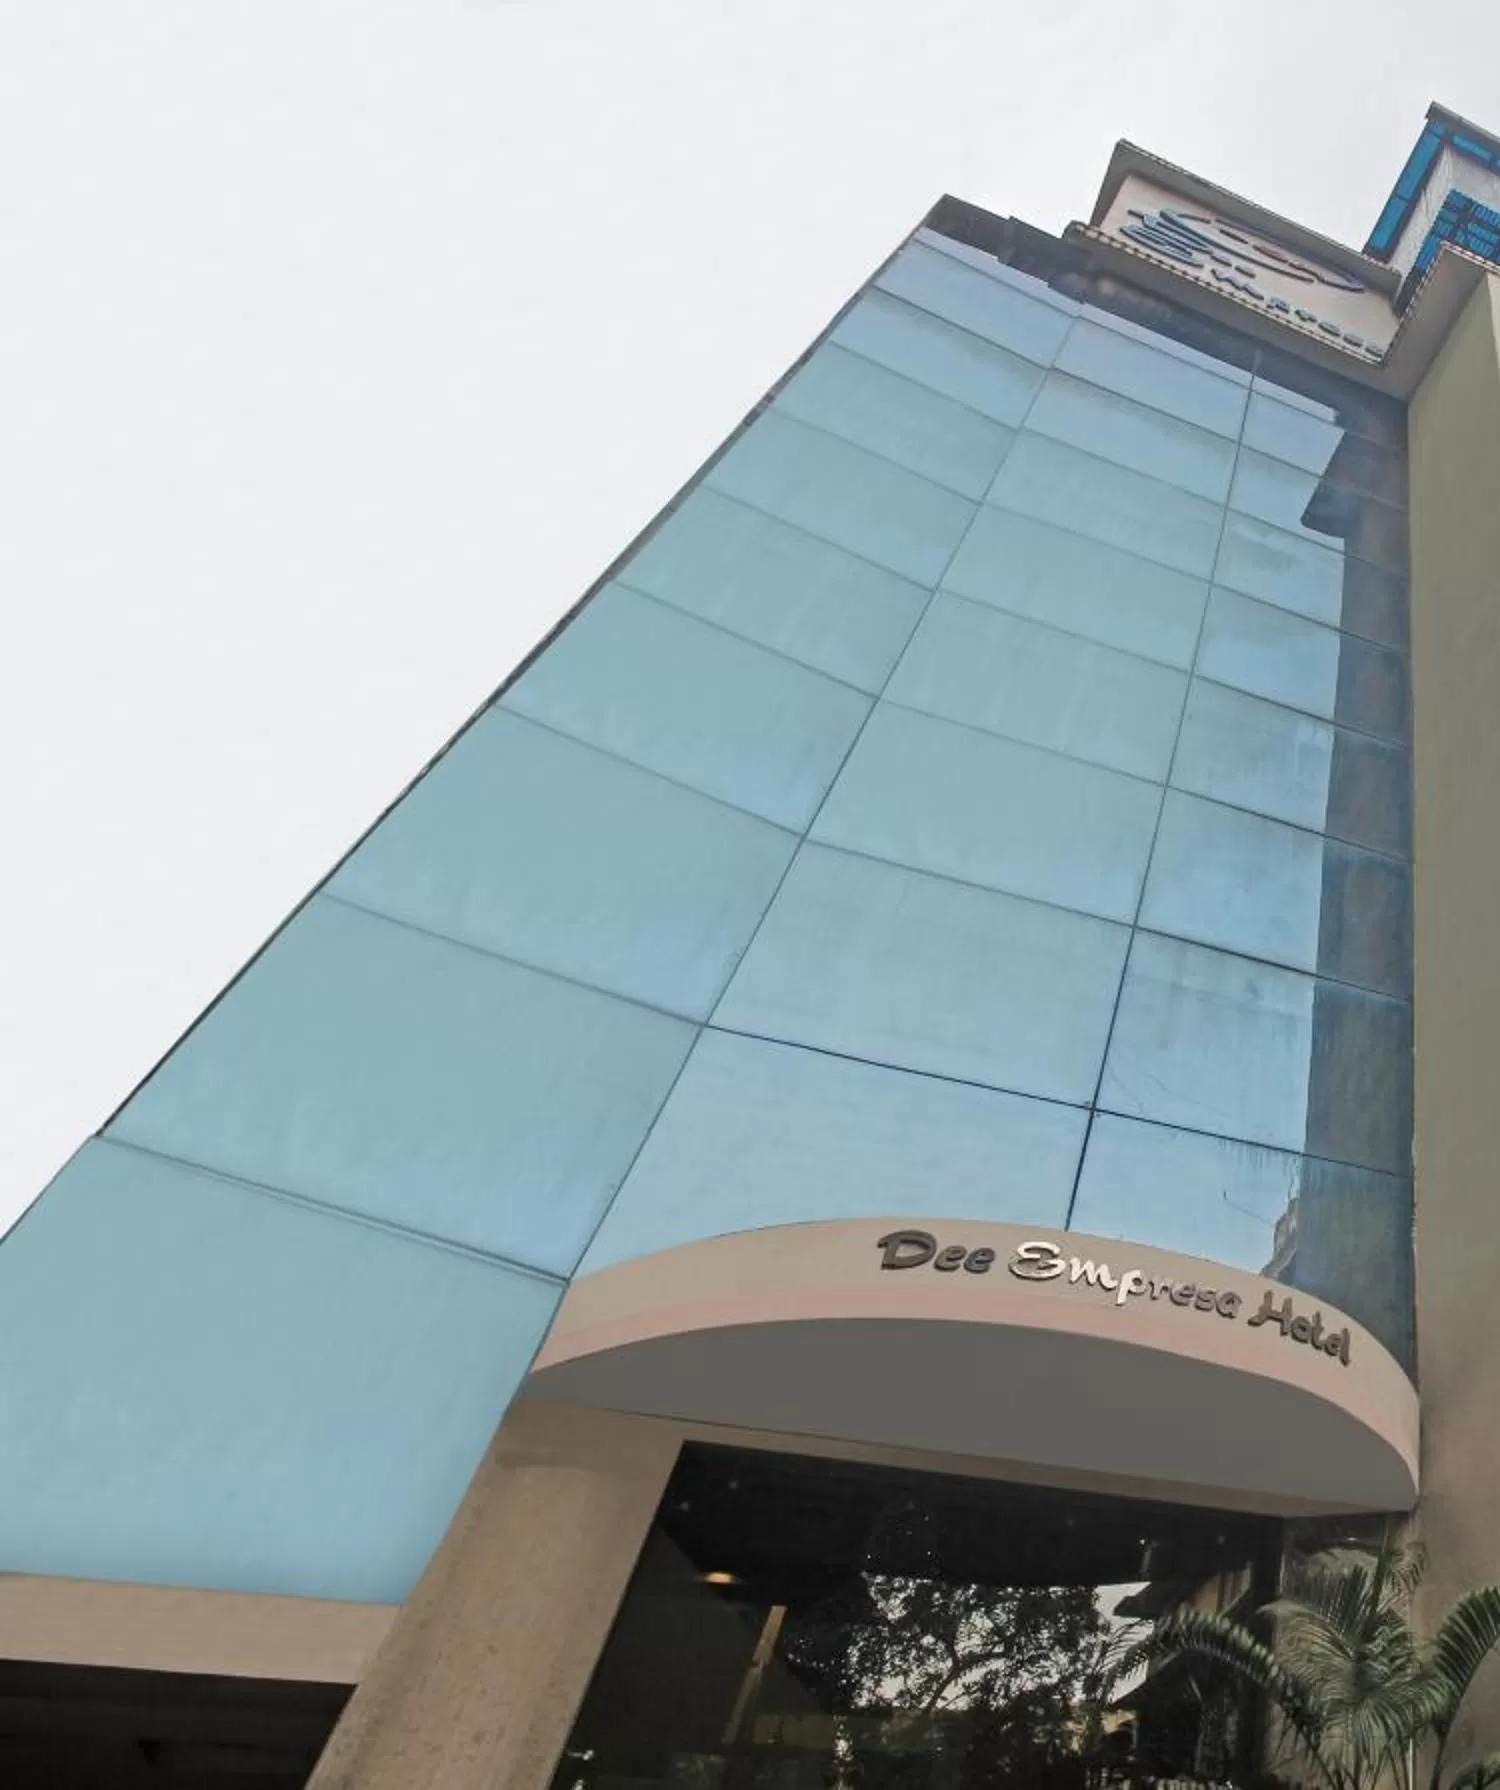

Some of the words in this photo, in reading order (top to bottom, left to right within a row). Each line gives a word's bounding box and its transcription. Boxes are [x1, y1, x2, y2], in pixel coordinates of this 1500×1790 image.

[877, 1229, 997, 1275] Dee
[1009, 1240, 1243, 1320] Empresa
[1249, 1290, 1353, 1367] Hotel
